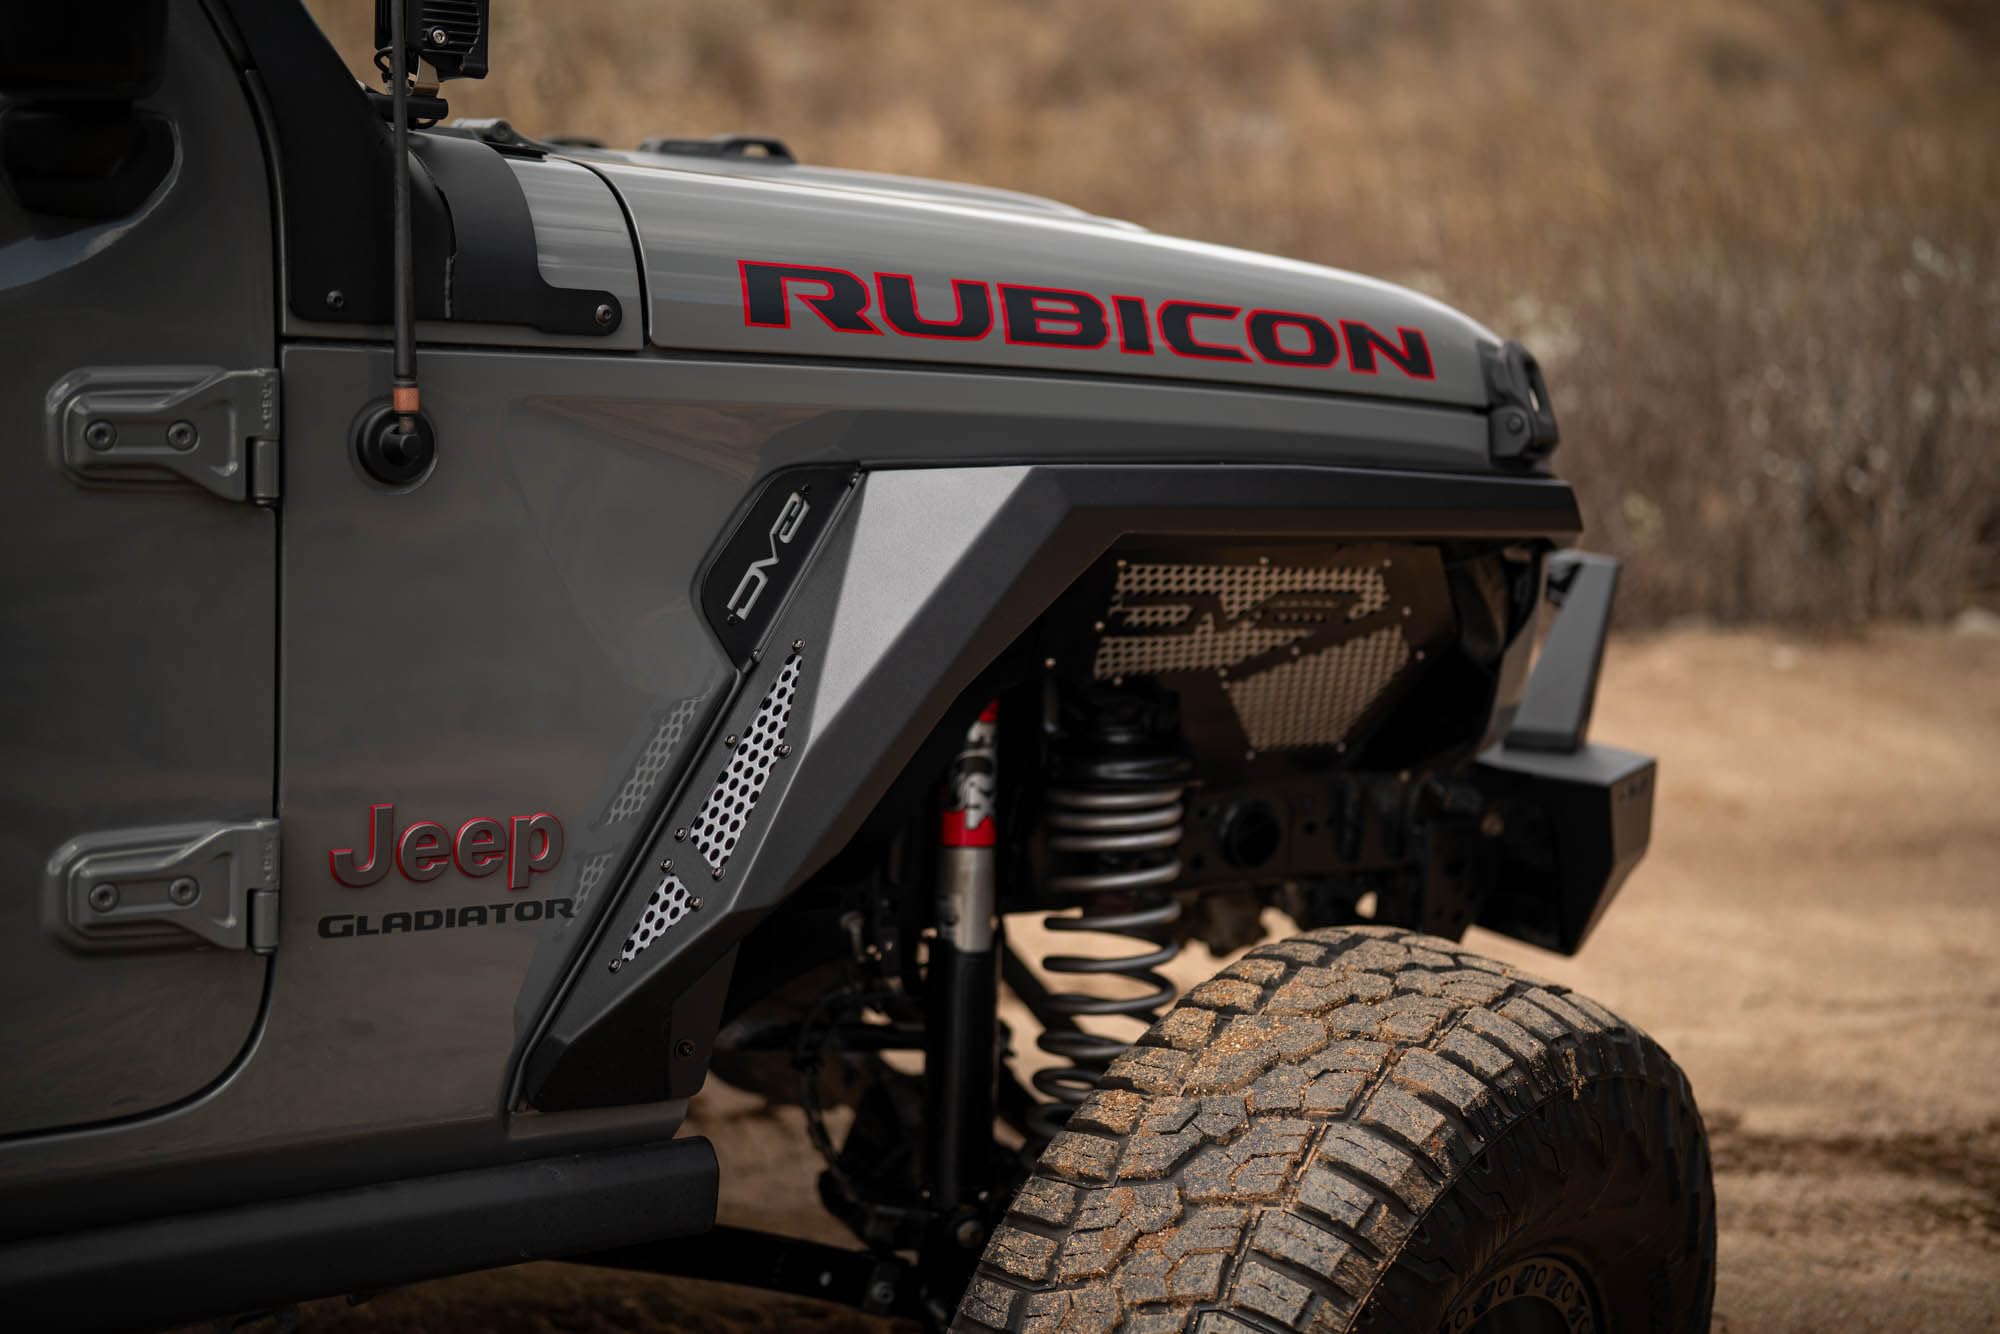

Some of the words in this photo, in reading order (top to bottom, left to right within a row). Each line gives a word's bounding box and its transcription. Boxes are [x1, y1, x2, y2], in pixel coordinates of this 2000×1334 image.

[739, 260, 1436, 379] RUBICON
[727, 491, 810, 621] DV8
[330, 803, 565, 890] Jeep
[318, 898, 577, 938] GLADIATOR
